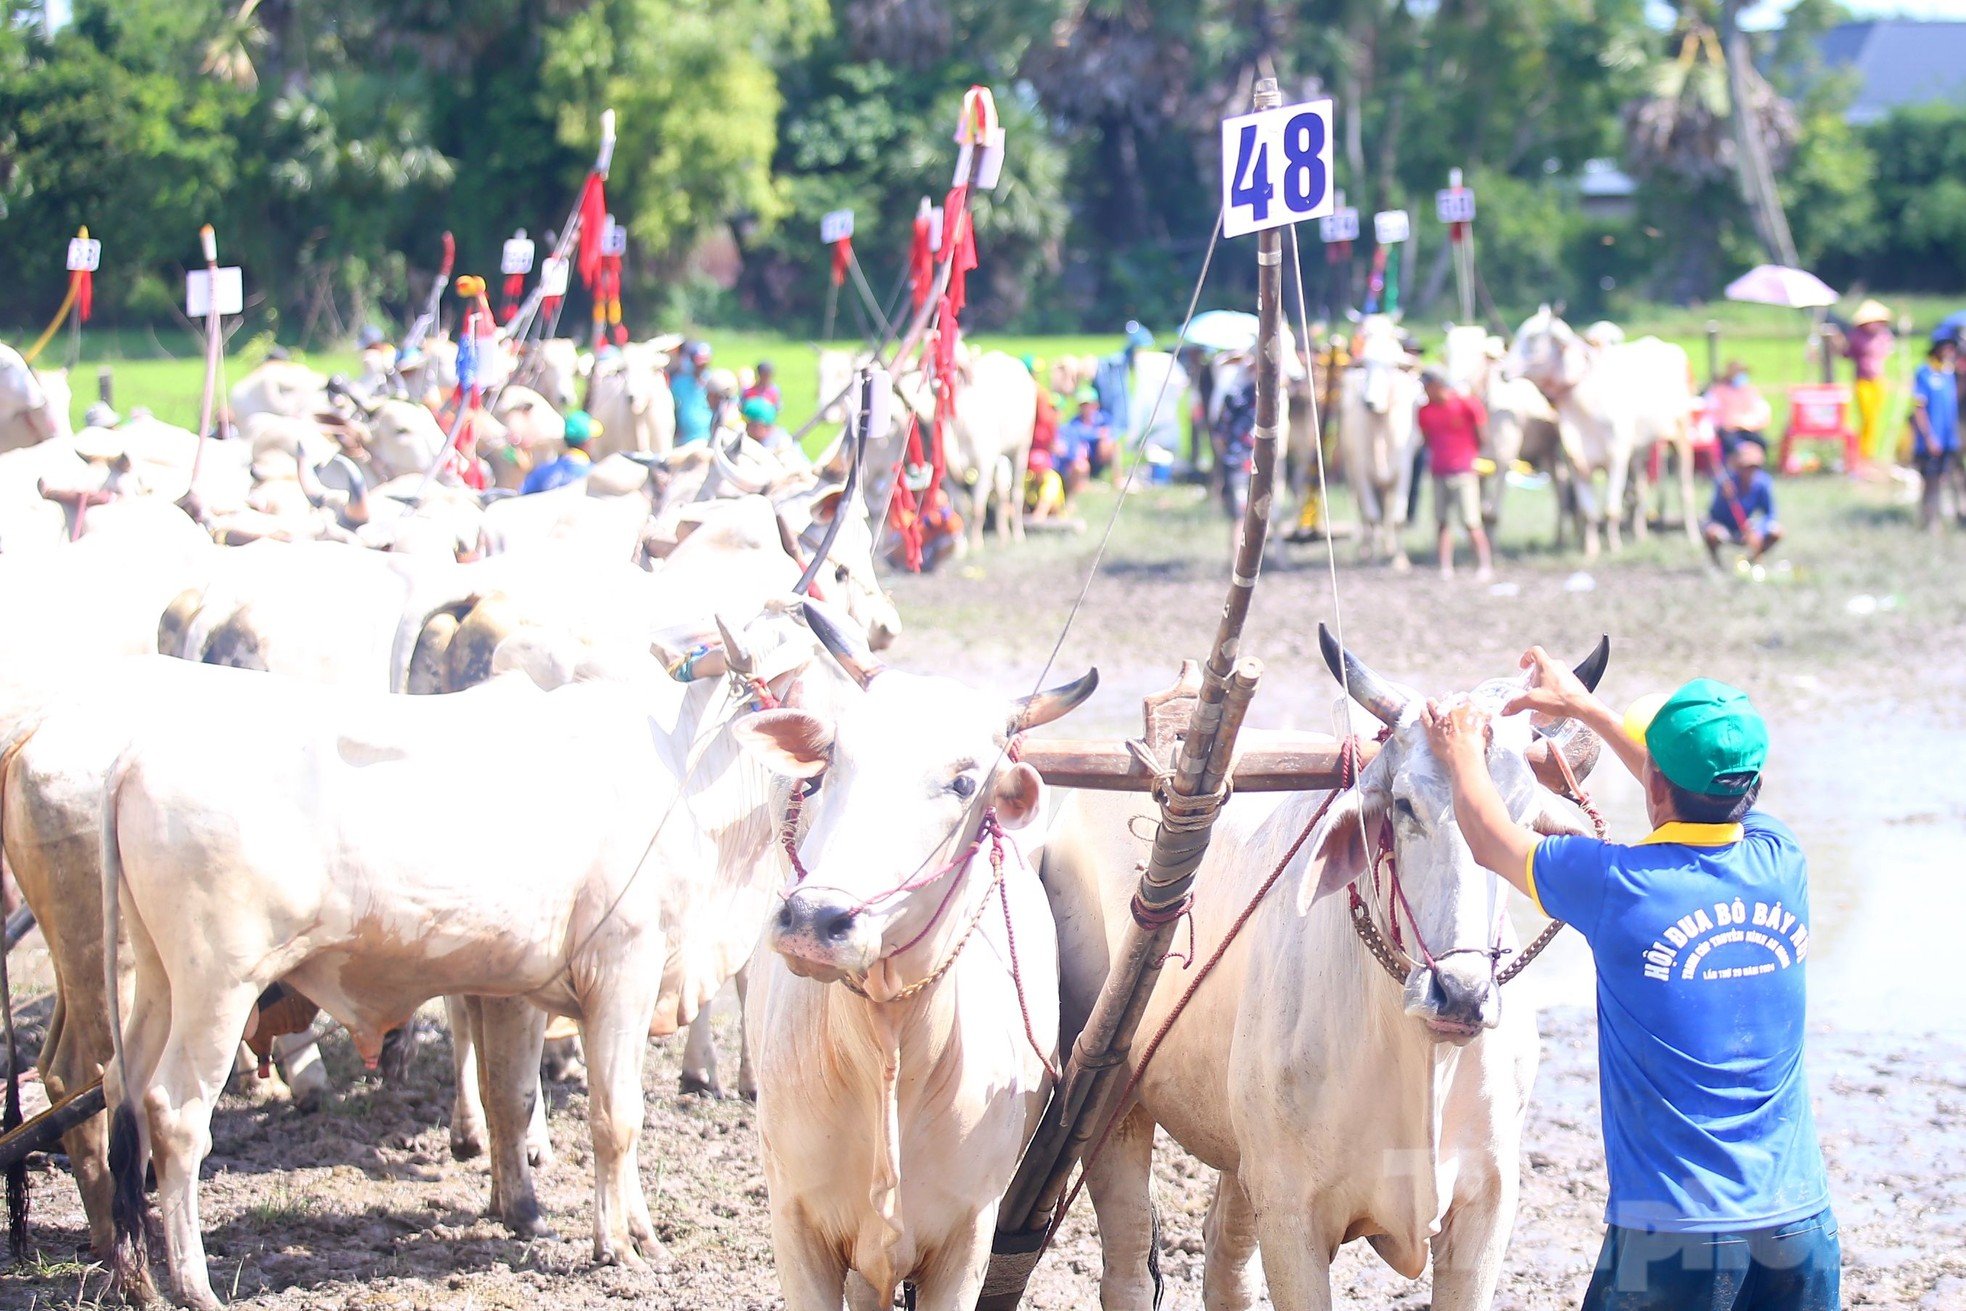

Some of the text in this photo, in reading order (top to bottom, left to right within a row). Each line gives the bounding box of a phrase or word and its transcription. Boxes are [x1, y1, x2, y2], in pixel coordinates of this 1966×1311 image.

[1231, 112, 1326, 222] 48
[1642, 941, 1678, 981] HỘI
[1663, 908, 1714, 949] ĐUA
[1714, 896, 1746, 926] BÒ
[1752, 901, 1796, 935] BẢY
